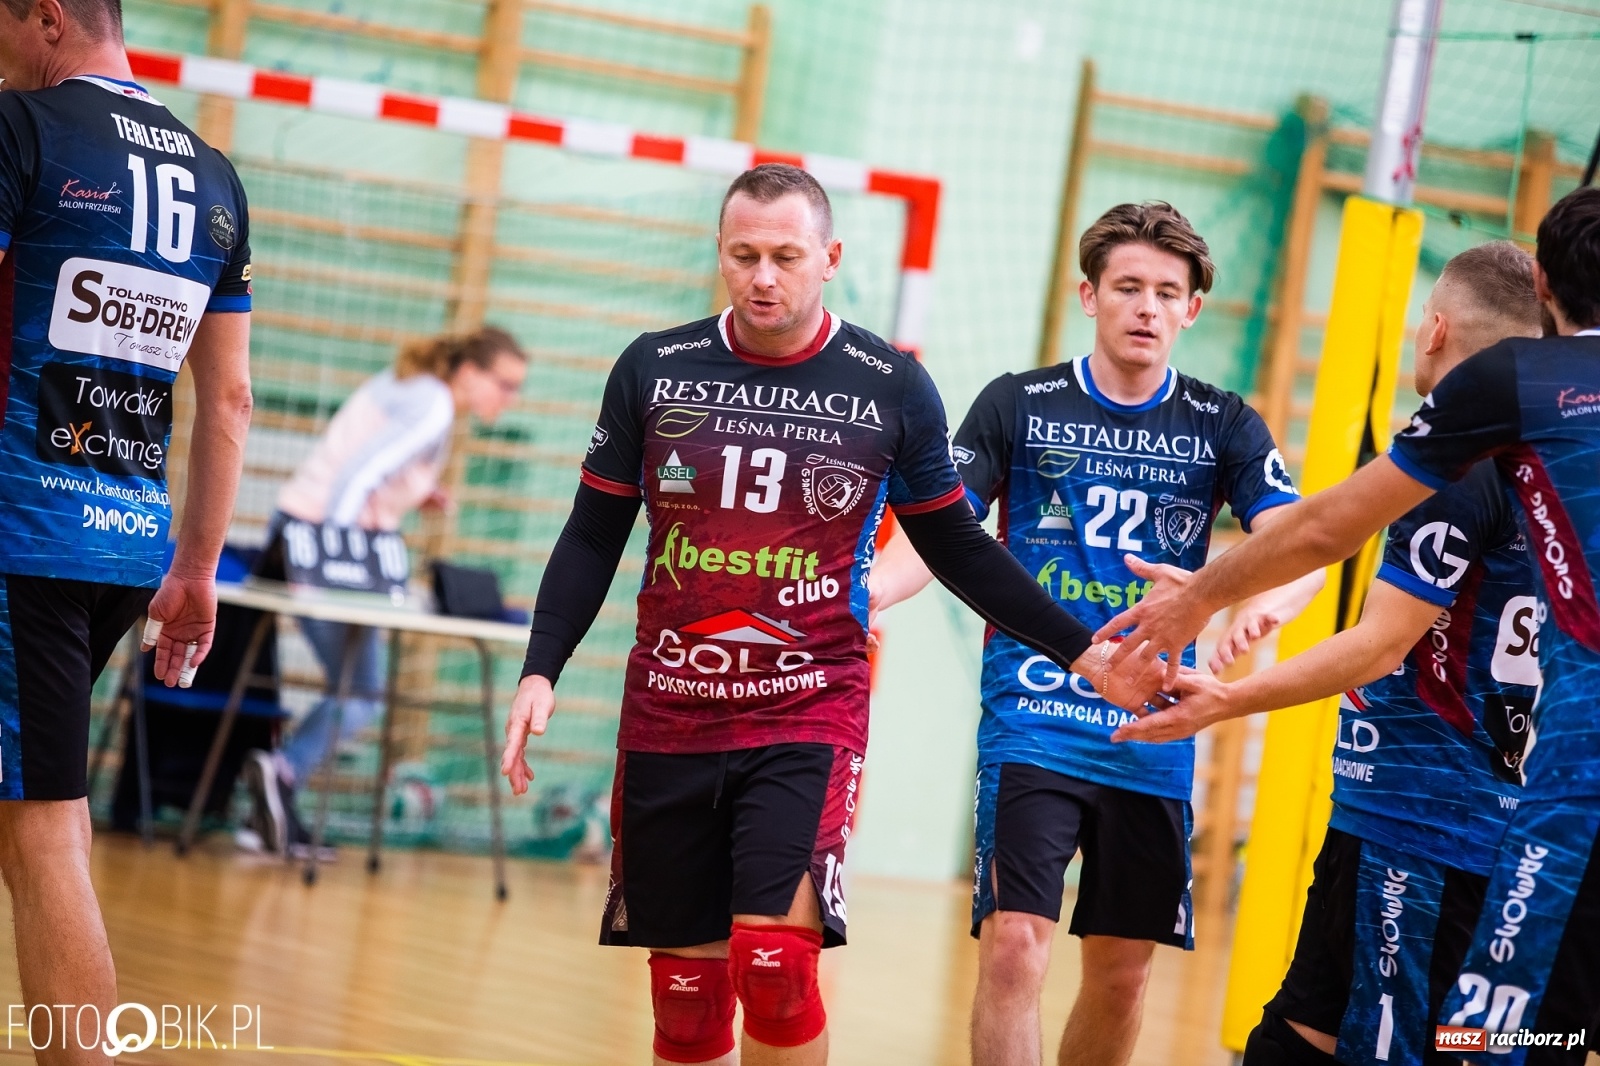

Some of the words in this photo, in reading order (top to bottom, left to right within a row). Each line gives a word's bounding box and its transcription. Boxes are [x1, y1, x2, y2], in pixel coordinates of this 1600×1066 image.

[110, 112, 196, 158] TERLECKI
[58, 200, 84, 210] SALON
[85, 202, 122, 214] FRYZJERSKI
[127, 153, 196, 263] 16
[67, 270, 197, 344] SOB-DREW
[106, 286, 189, 312] TOLARSTWO
[650, 377, 883, 425] RESTAURACJA
[1561, 404, 1592, 419] SALON
[713, 414, 776, 438] LEŚNA
[783, 422, 842, 445] PERŁA
[1026, 414, 1217, 464] RESTAURACJA
[657, 467, 694, 480] LASEL
[720, 444, 787, 514] 13
[1085, 458, 1134, 479] LEŚNA
[1139, 465, 1188, 485] PERŁA
[82, 503, 159, 538] DAMONS
[1040, 504, 1072, 518] LASEL
[1085, 484, 1149, 552] 22
[677, 536, 819, 581] bestfit
[777, 575, 840, 607] club
[652, 628, 814, 675] GOLD
[648, 670, 728, 699] POKRYCIA
[732, 670, 828, 699] DACHOWE
[1017, 654, 1103, 698] GO
[1016, 696, 1103, 726] POKRYCIA
[1334, 757, 1375, 782] DACHOWE
[1378, 867, 1409, 978] DAMONS
[1489, 843, 1549, 963] DAMONS
[1375, 993, 1394, 1062] 1
[1446, 973, 1531, 1054] 20
